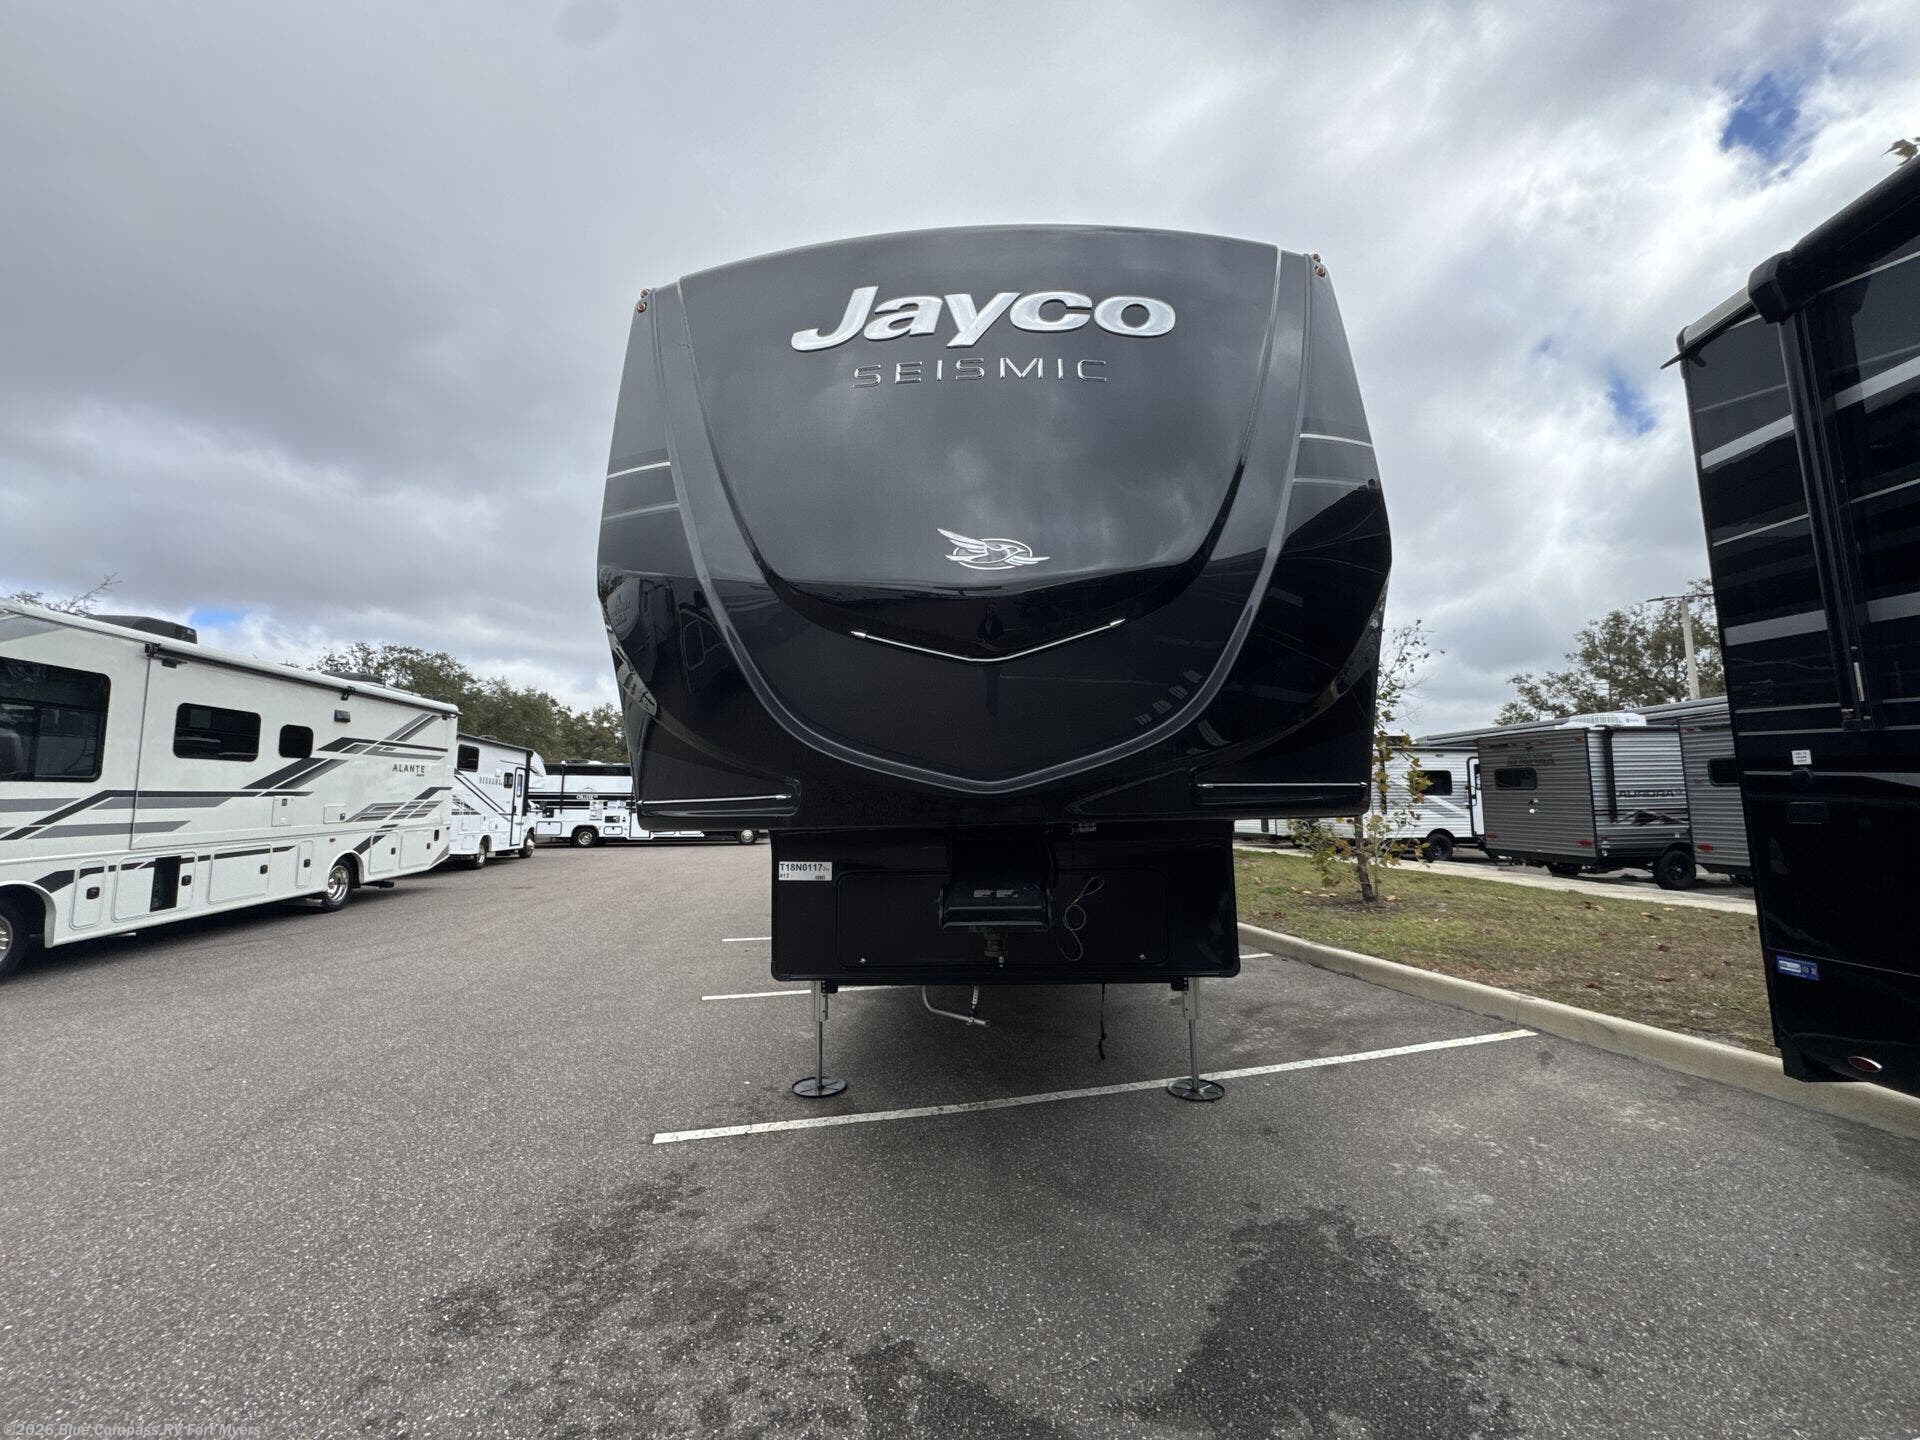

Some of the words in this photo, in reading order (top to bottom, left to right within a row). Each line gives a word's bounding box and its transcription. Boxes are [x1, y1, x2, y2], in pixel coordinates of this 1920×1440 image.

[791, 286, 1176, 352] Jayco
[852, 357, 1108, 389] SEISMIC
[392, 763, 425, 774] ALANTE
[779, 863, 823, 872] T18N0117
